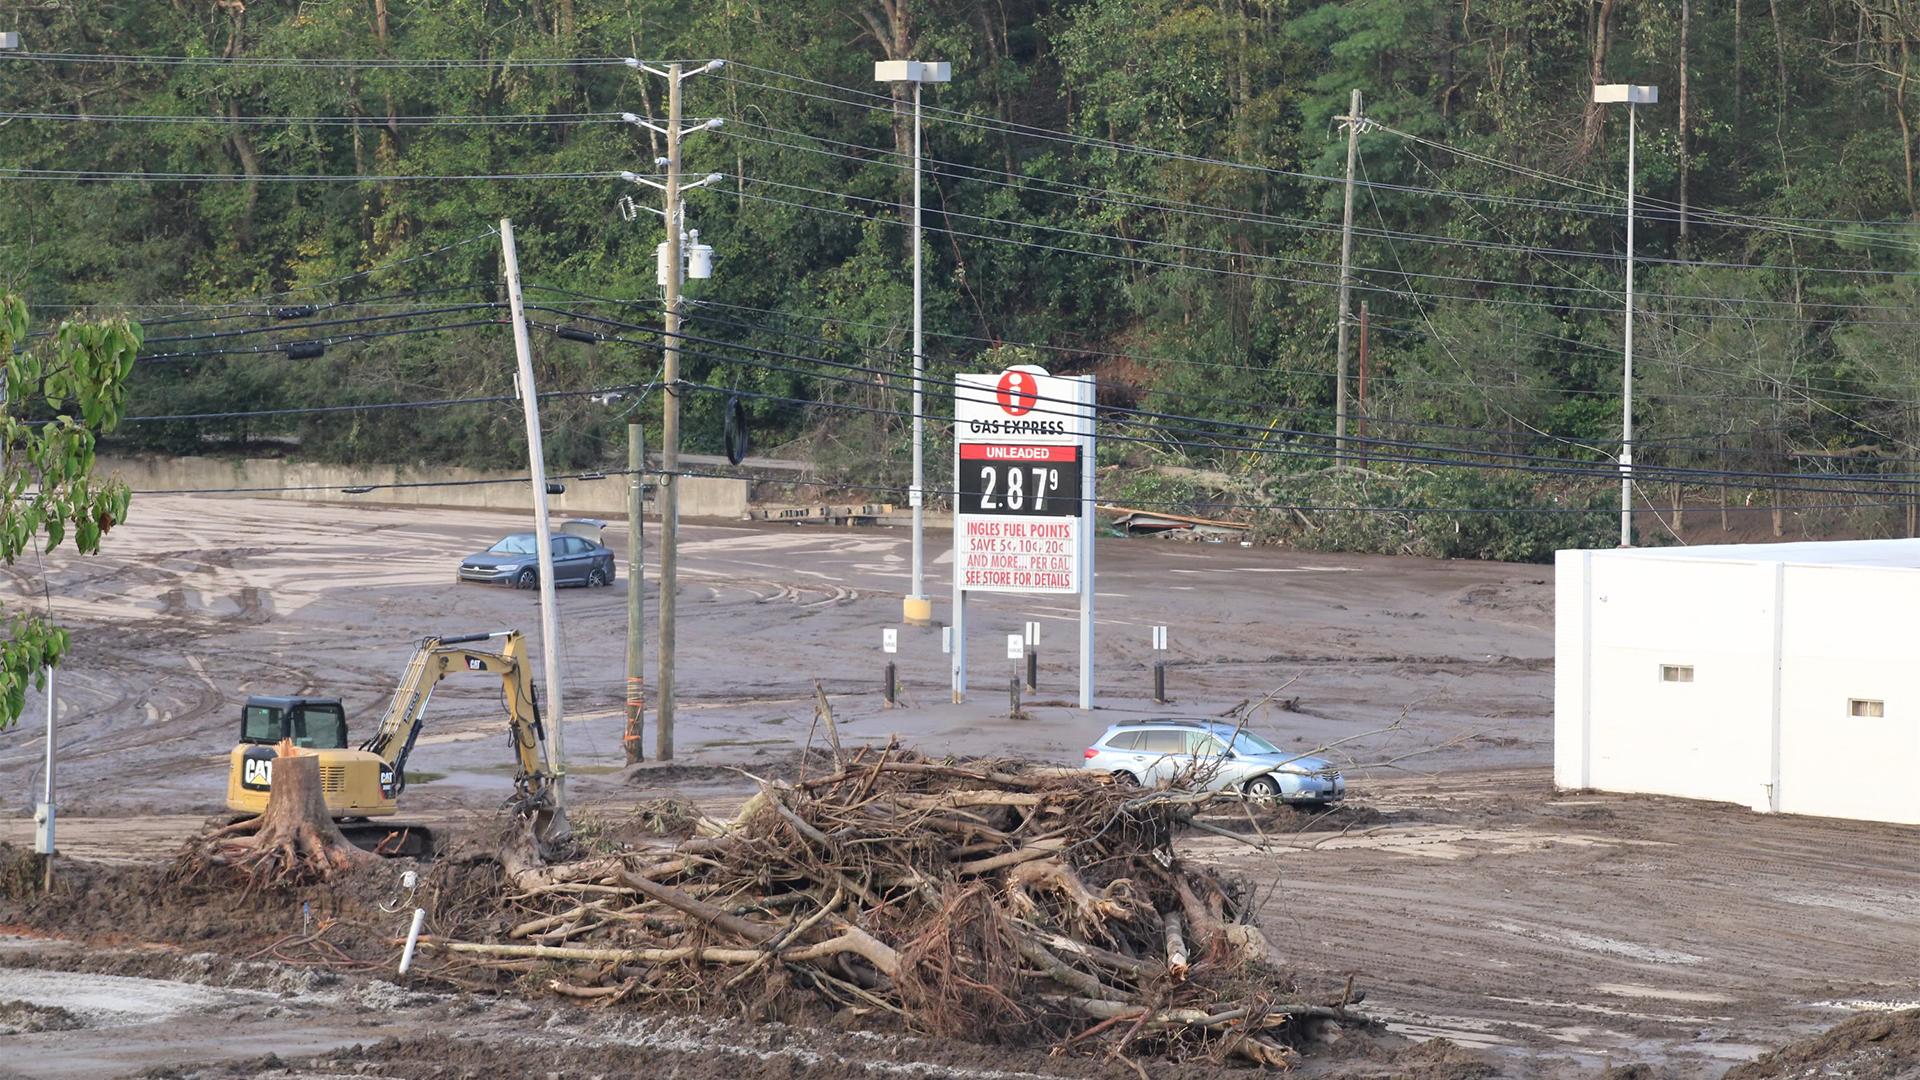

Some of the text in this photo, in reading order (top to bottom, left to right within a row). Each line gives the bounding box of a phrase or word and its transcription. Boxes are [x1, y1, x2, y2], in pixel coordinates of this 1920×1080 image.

[970, 420, 1064, 436] GAS EXPRESS
[986, 447, 1050, 459] UNLEADED
[967, 522, 1070, 538] INGLES FUEL POINTS
[970, 538, 996, 551] SAVE
[967, 554, 1070, 570] AND MORE... PER GAL
[965, 570, 1070, 587] SEE STORE FOR DETAILS
[470, 659, 480, 670] CAT
[245, 758, 272, 785] CAT
[380, 771, 393, 784] CAT
